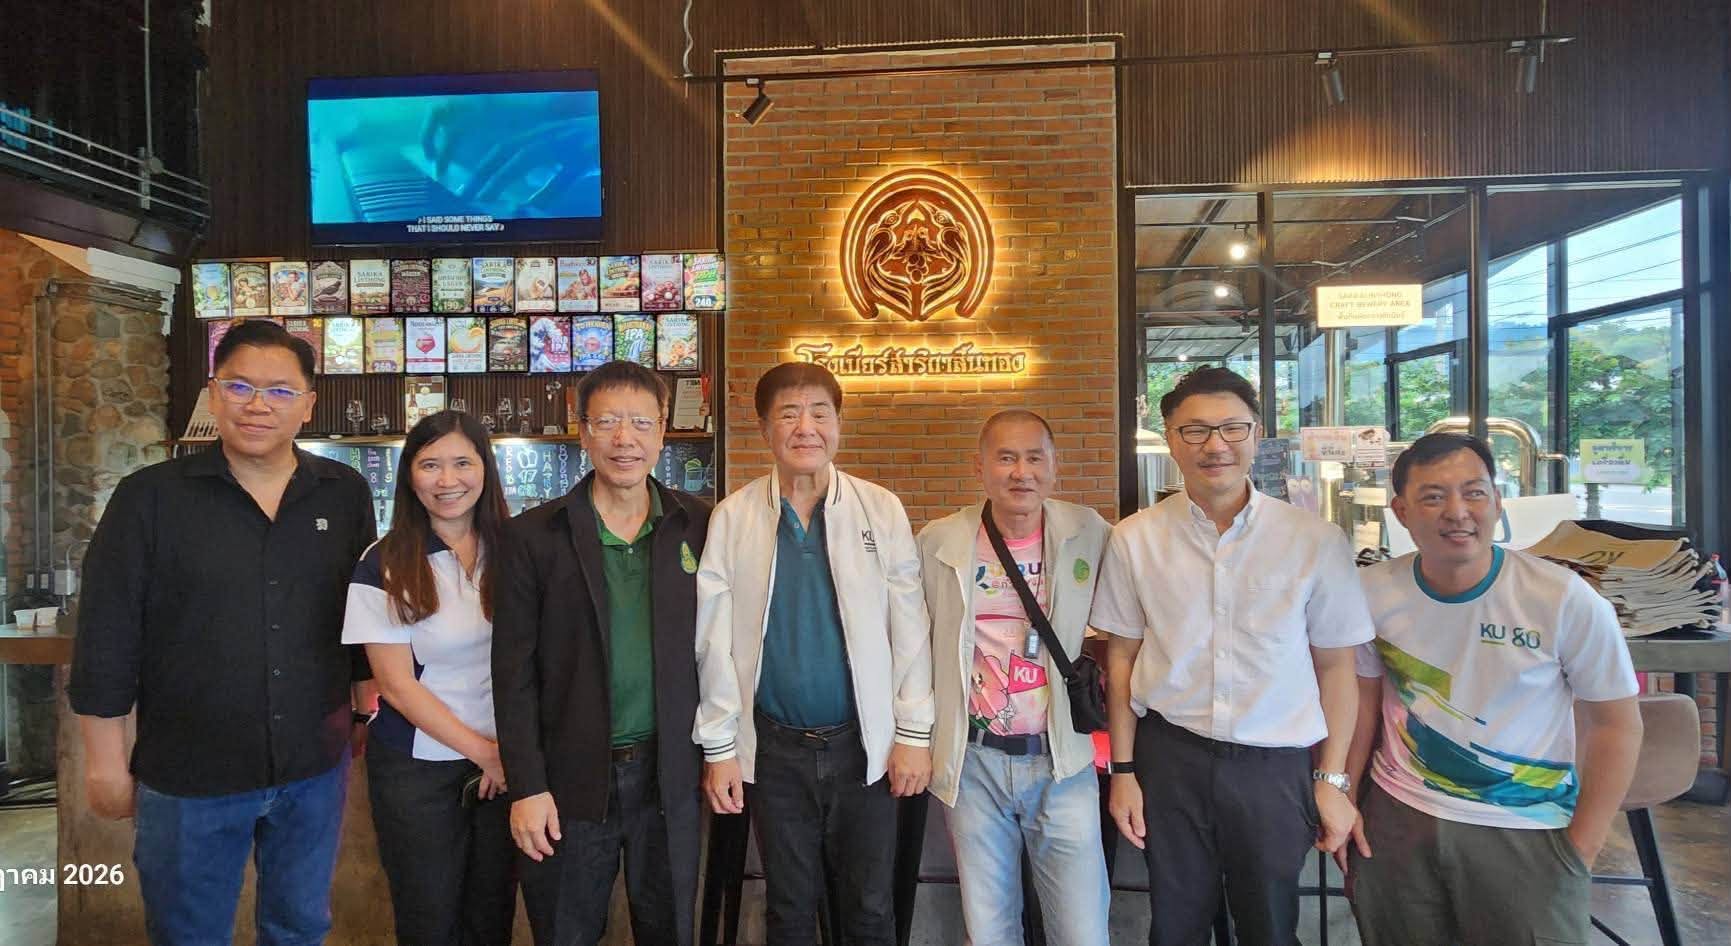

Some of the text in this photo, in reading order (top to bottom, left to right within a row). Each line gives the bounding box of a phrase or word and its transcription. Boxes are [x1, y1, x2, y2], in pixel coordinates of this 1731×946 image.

[426, 216, 442, 224] SAID
[466, 215, 494, 223] THINGS
[407, 224, 426, 232] THAT
[431, 224, 460, 232] SHOULD
[460, 224, 484, 232] NEVER
[485, 223, 498, 231] SAY
[625, 328, 644, 341] IPA
[1480, 622, 1506, 640] KU
[1014, 666, 1038, 684] KU
